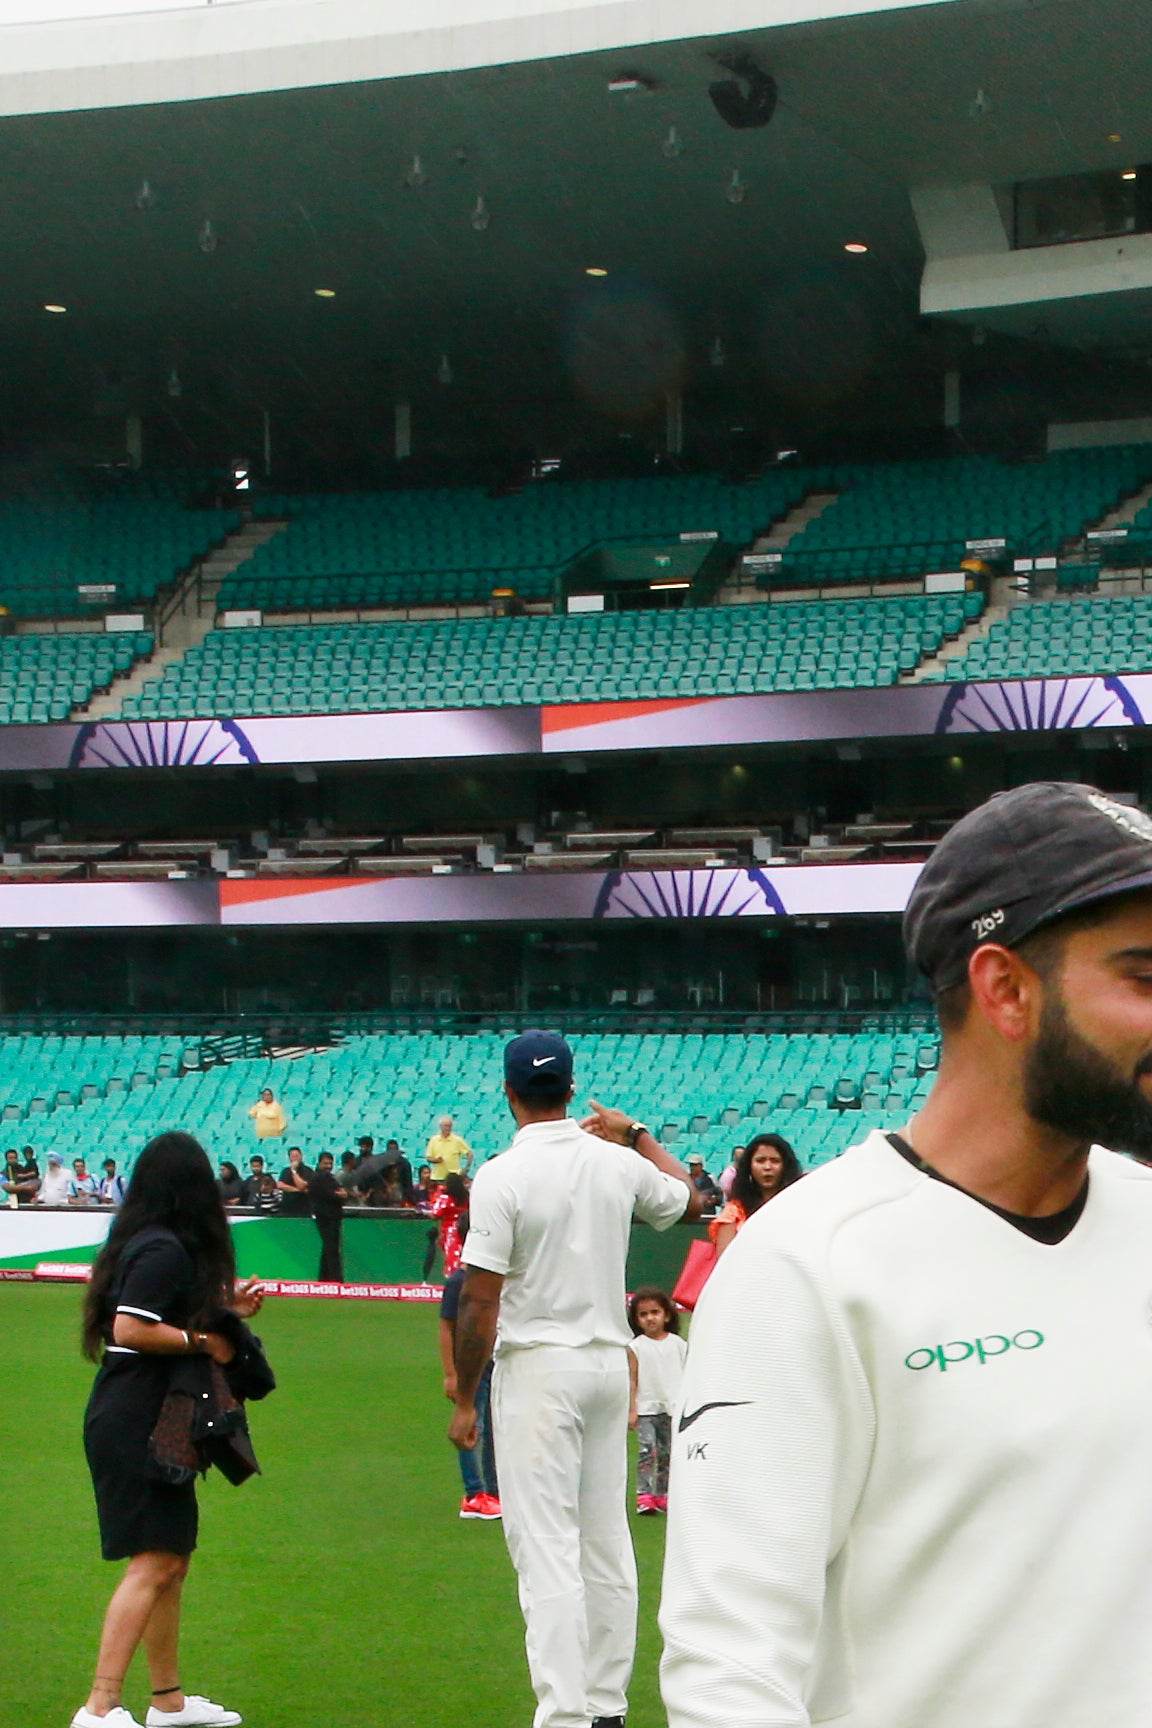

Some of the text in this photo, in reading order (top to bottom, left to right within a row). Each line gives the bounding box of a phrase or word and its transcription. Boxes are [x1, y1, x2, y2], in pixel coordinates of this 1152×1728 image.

[972, 909, 1004, 939] 269
[340, 1286, 369, 1296] bet365
[370, 1287, 399, 1297] bet365
[401, 1287, 431, 1298] bet365
[687, 1443, 709, 1460] VK
